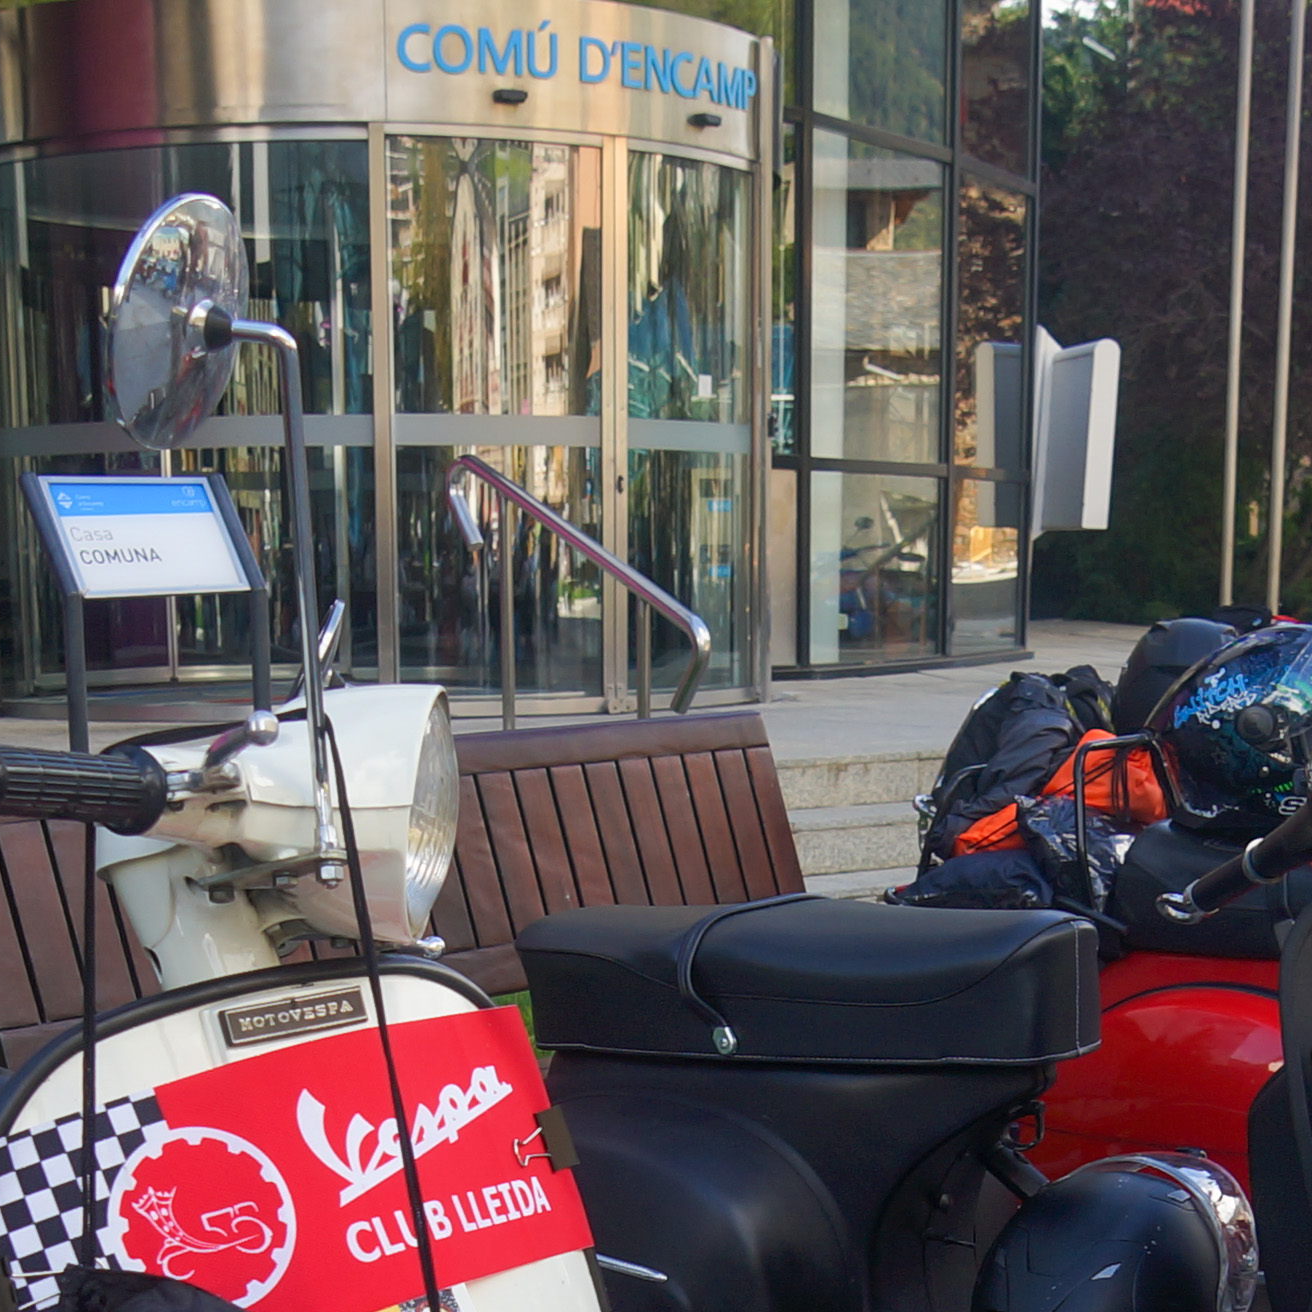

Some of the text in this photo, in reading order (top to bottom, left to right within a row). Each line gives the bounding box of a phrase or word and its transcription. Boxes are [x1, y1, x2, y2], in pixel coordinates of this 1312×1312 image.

[397, 20, 757, 111] COMÚ D'ENCAMP
[69, 526, 114, 542] Casa
[79, 548, 163, 565] COMUNA
[239, 1000, 353, 1031] MOTOVESPA
[296, 1065, 513, 1208] Vespa
[346, 1176, 552, 1263] CLUB LLEIDA
